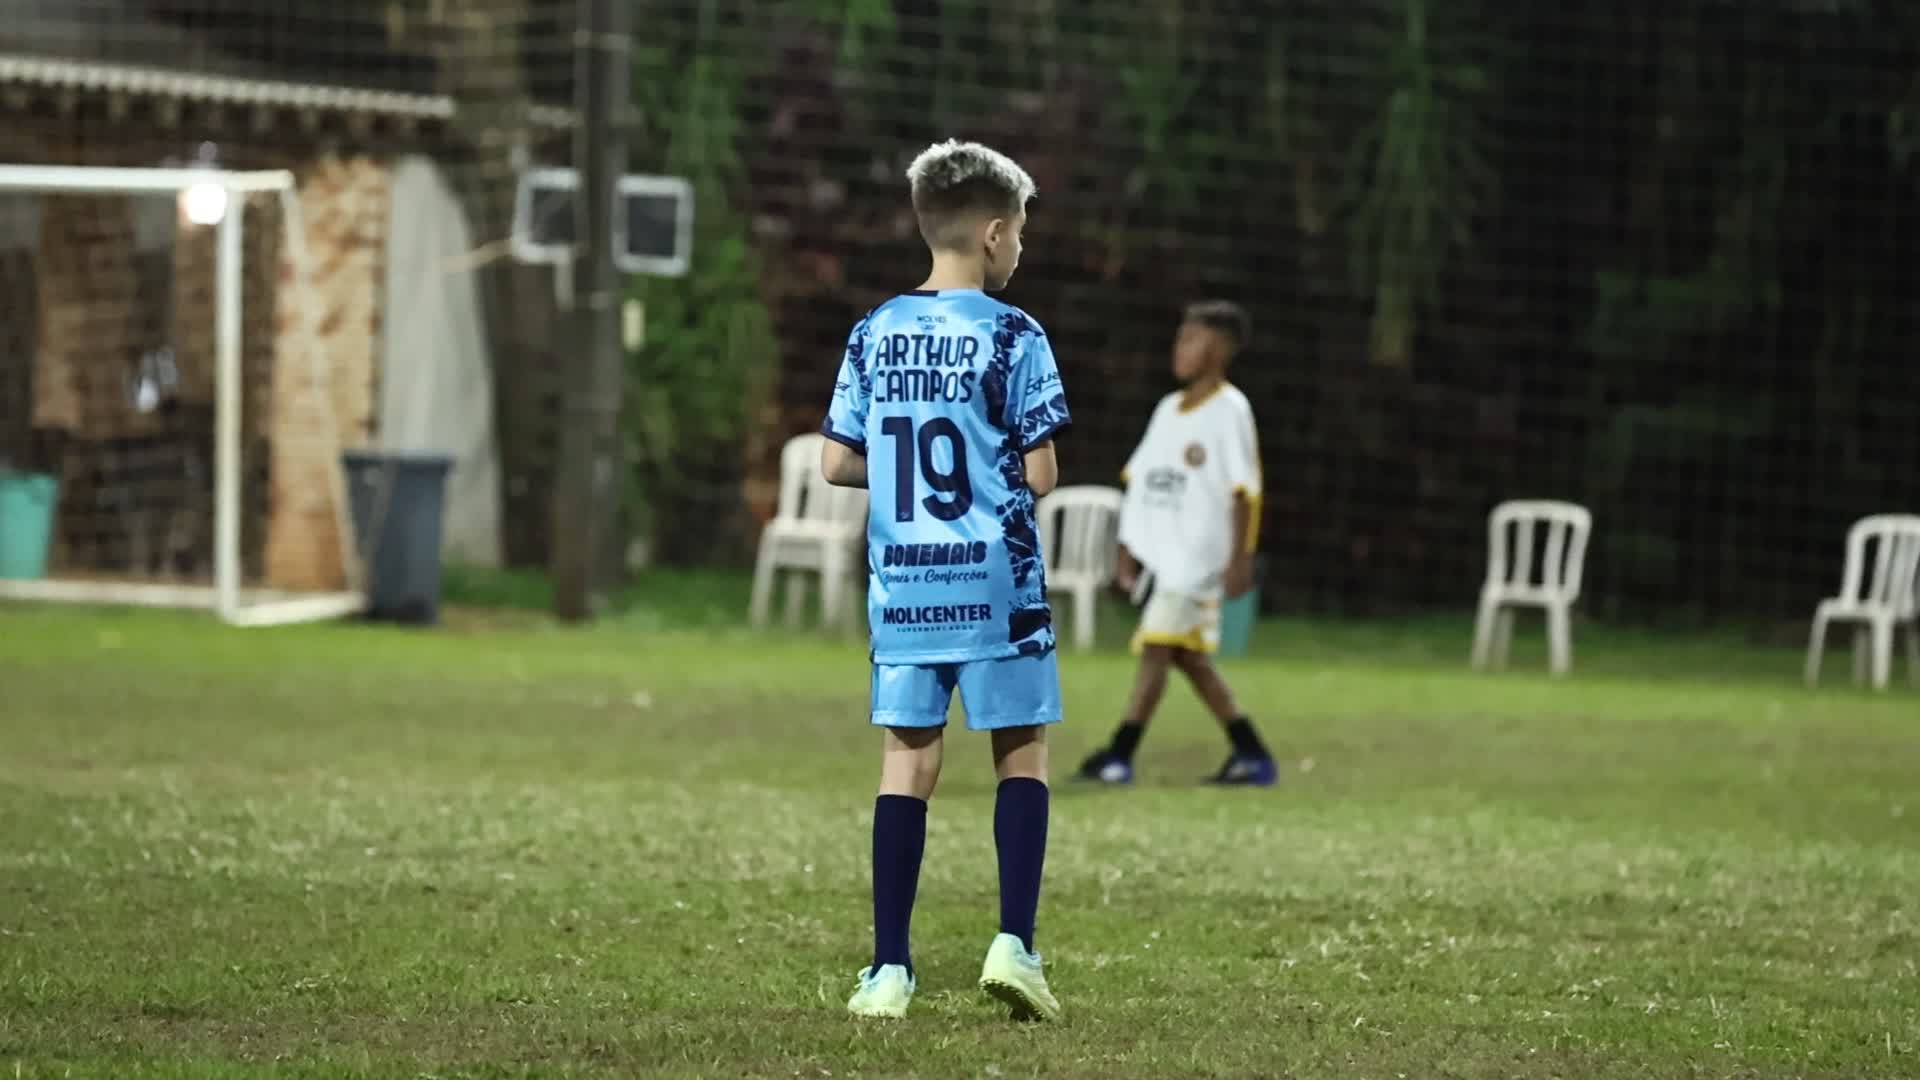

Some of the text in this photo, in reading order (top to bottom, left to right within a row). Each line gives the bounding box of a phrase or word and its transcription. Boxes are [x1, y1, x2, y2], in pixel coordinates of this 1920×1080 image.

[876, 334, 978, 367] ARTHUR
[875, 370, 976, 403] CAMPOS
[881, 416, 973, 522] 19
[883, 541, 987, 567] BONEMAIS
[913, 573, 920, 583] e
[924, 568, 988, 585] Confecções
[883, 604, 992, 624] MOLICENTER
